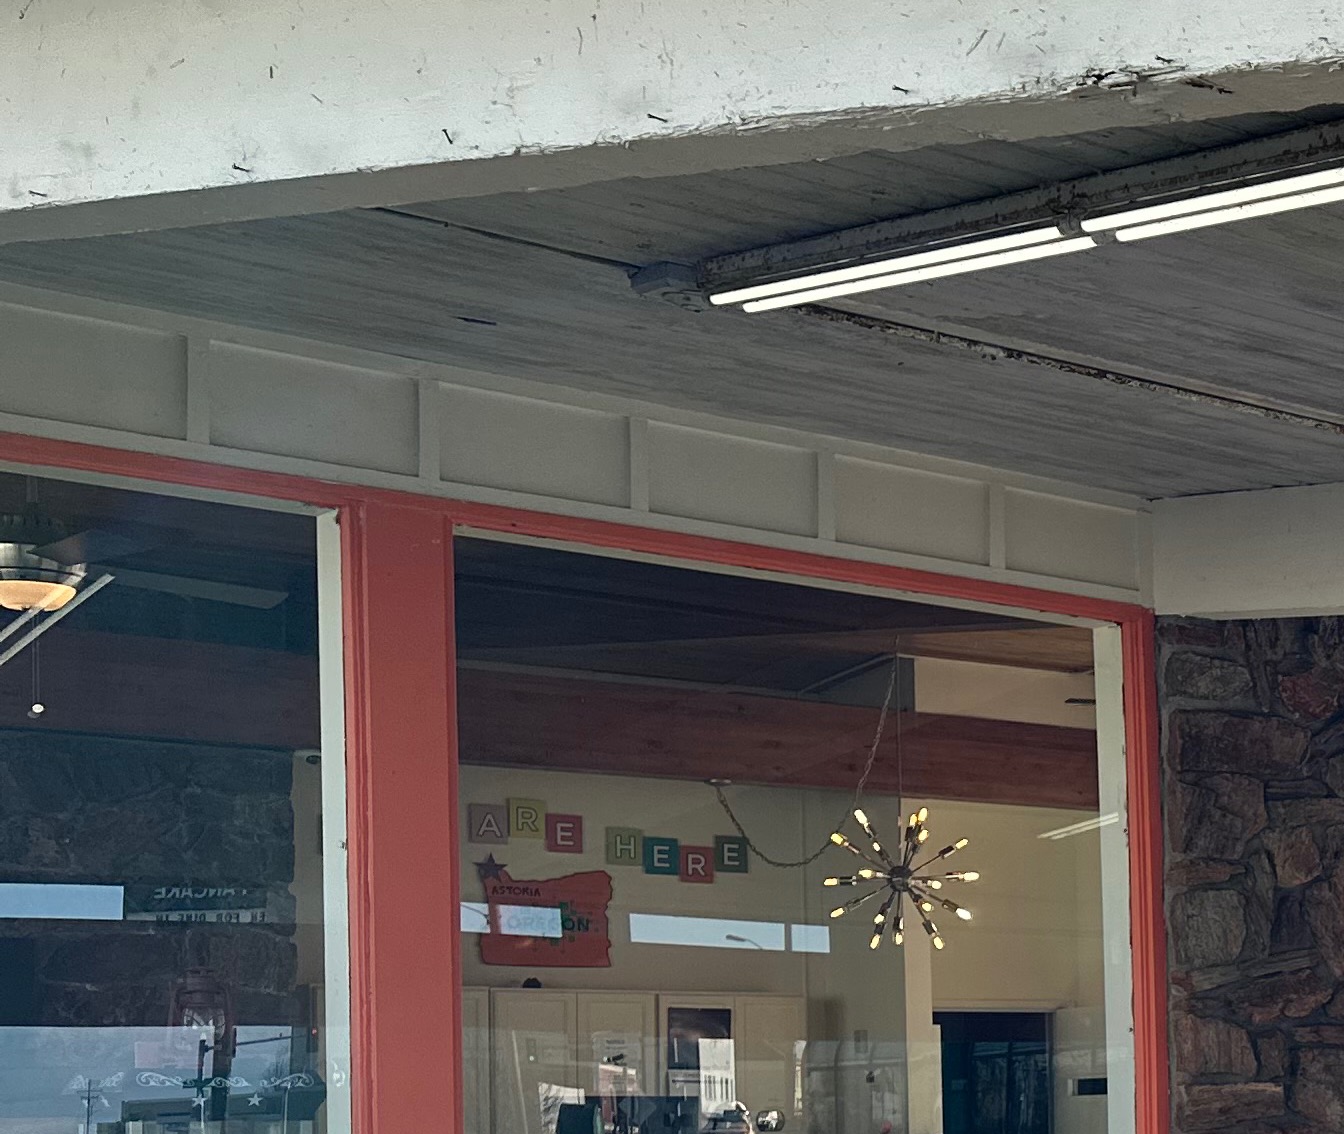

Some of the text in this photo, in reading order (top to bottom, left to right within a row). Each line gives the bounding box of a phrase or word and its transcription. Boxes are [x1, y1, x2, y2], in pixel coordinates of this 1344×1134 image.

[478, 806, 741, 877] ARE HERE
[491, 885, 541, 897] ASTORIA
